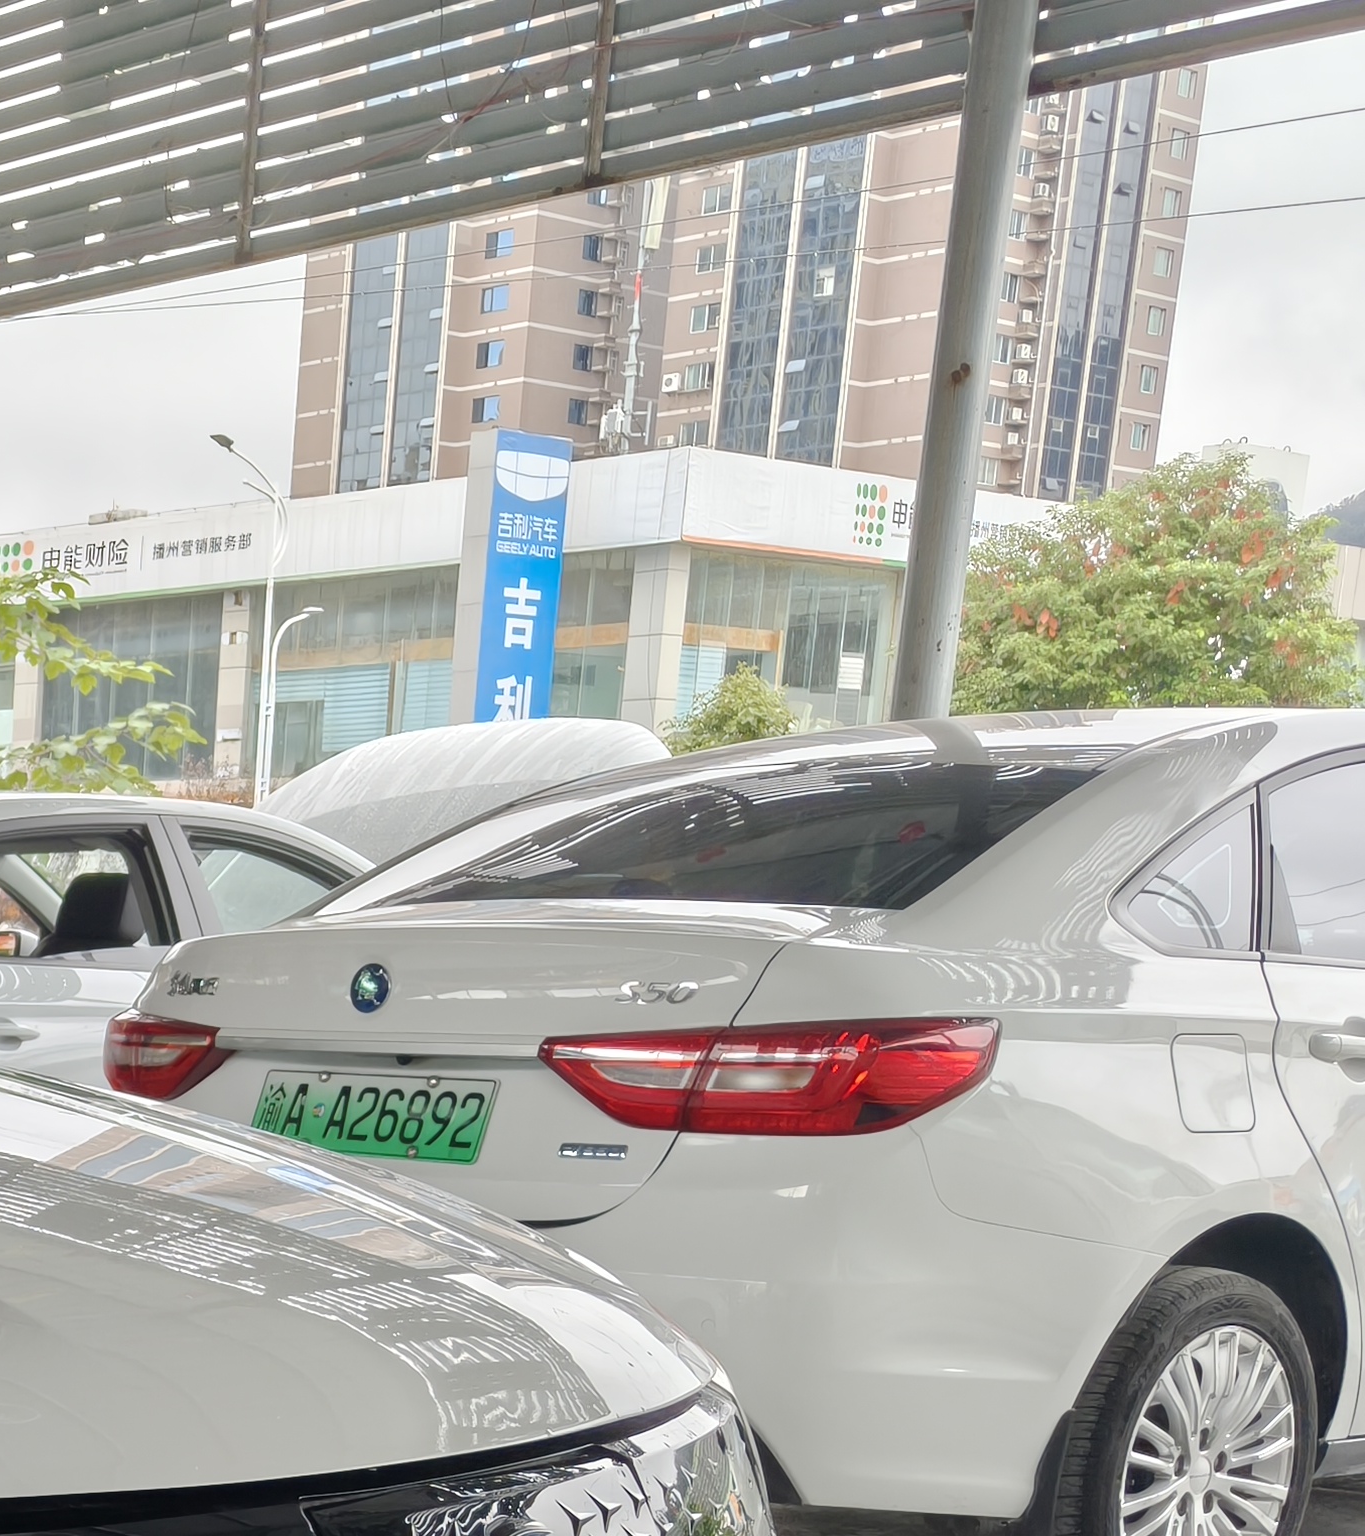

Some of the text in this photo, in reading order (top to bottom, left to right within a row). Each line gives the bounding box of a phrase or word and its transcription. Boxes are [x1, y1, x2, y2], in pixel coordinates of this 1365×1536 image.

[497, 512, 559, 543] 吉利汽车
[41, 538, 130, 572] 申能财险
[152, 533, 253, 561] 播州营销服务部
[496, 540, 557, 559] GEELY AUTO
[614, 980, 700, 1005] S50
[322, 1085, 486, 1149] A26892
